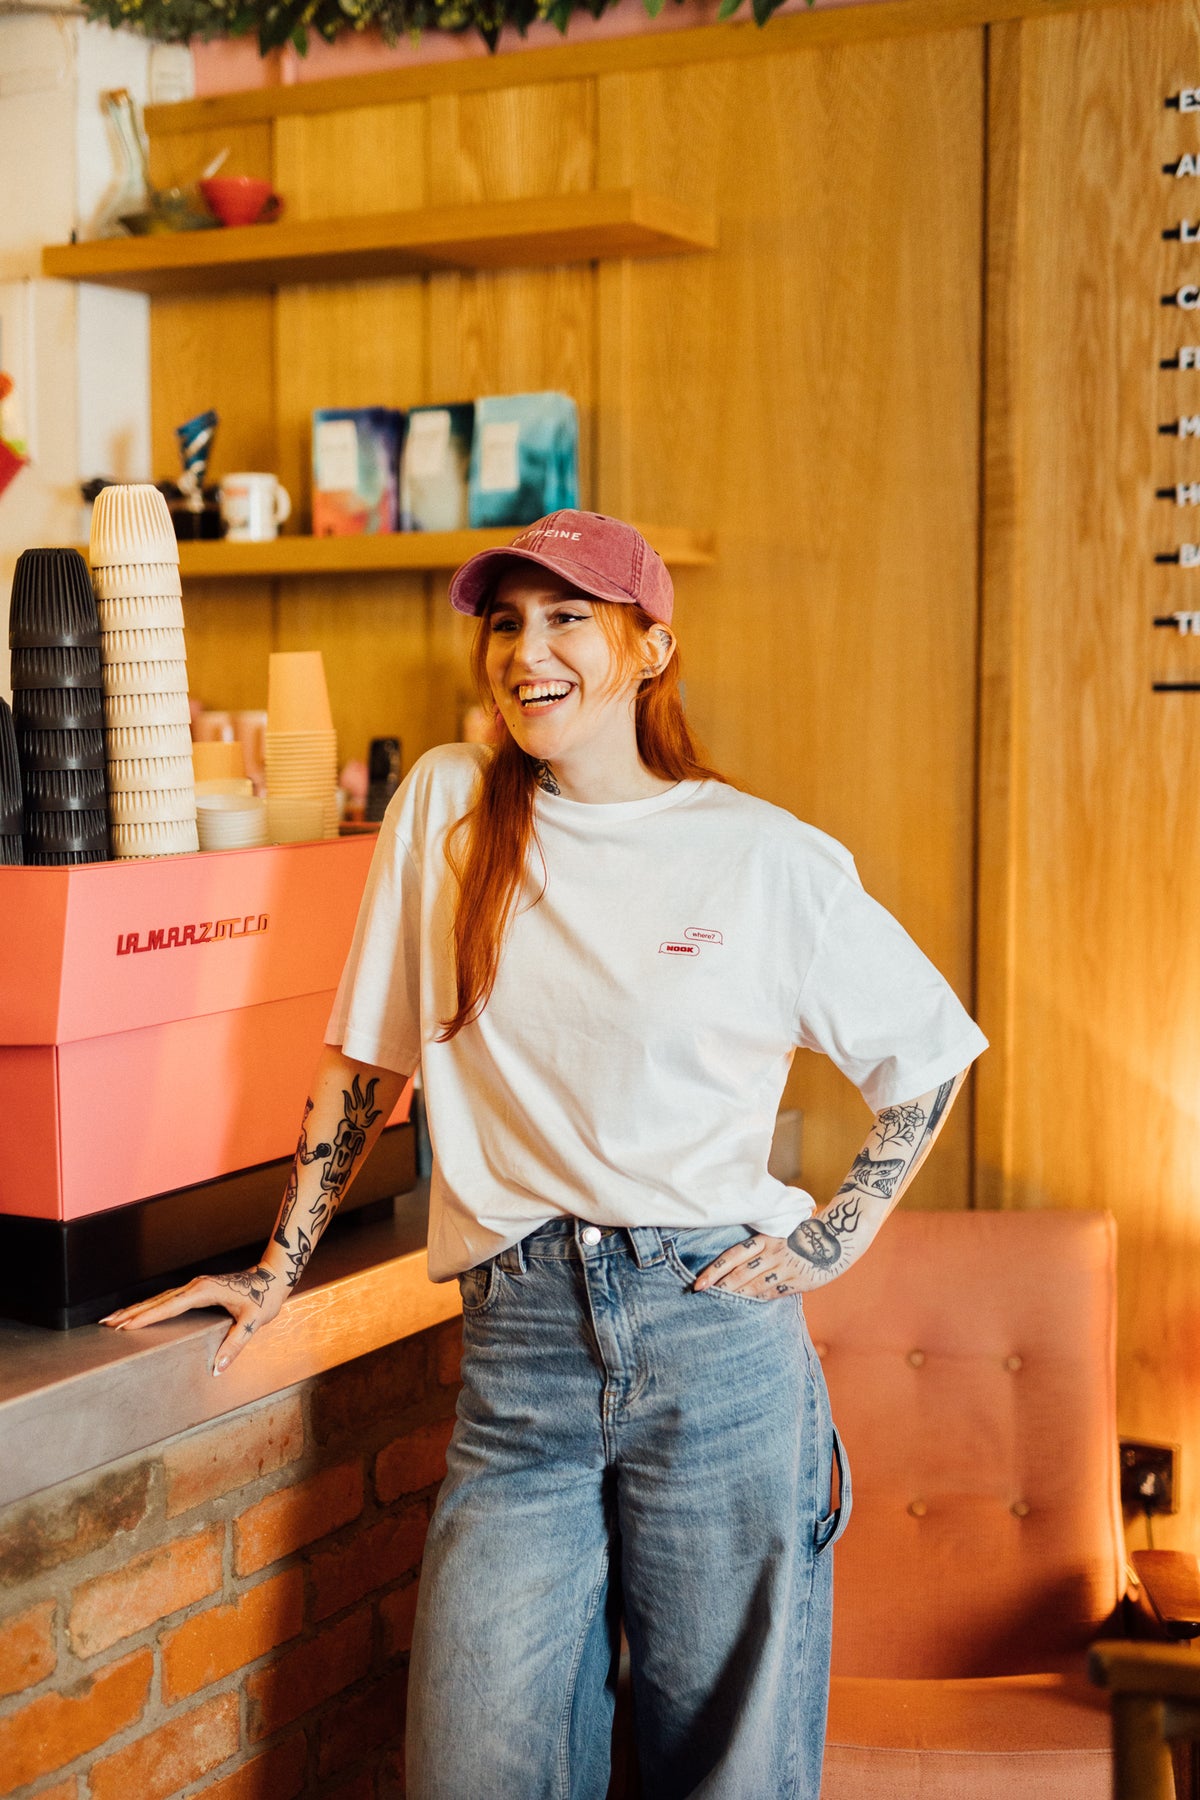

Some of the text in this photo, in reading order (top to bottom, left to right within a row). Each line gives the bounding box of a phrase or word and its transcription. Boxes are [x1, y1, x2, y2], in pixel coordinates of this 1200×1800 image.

[1175, 153, 1200, 179] A
[1180, 219, 1200, 243] L
[1177, 284, 1200, 311] C
[1179, 346, 1200, 371] F
[1176, 482, 1200, 507] H
[1180, 543, 1200, 568] B
[116, 932, 143, 956] LA
[666, 945, 694, 953] NOOK
